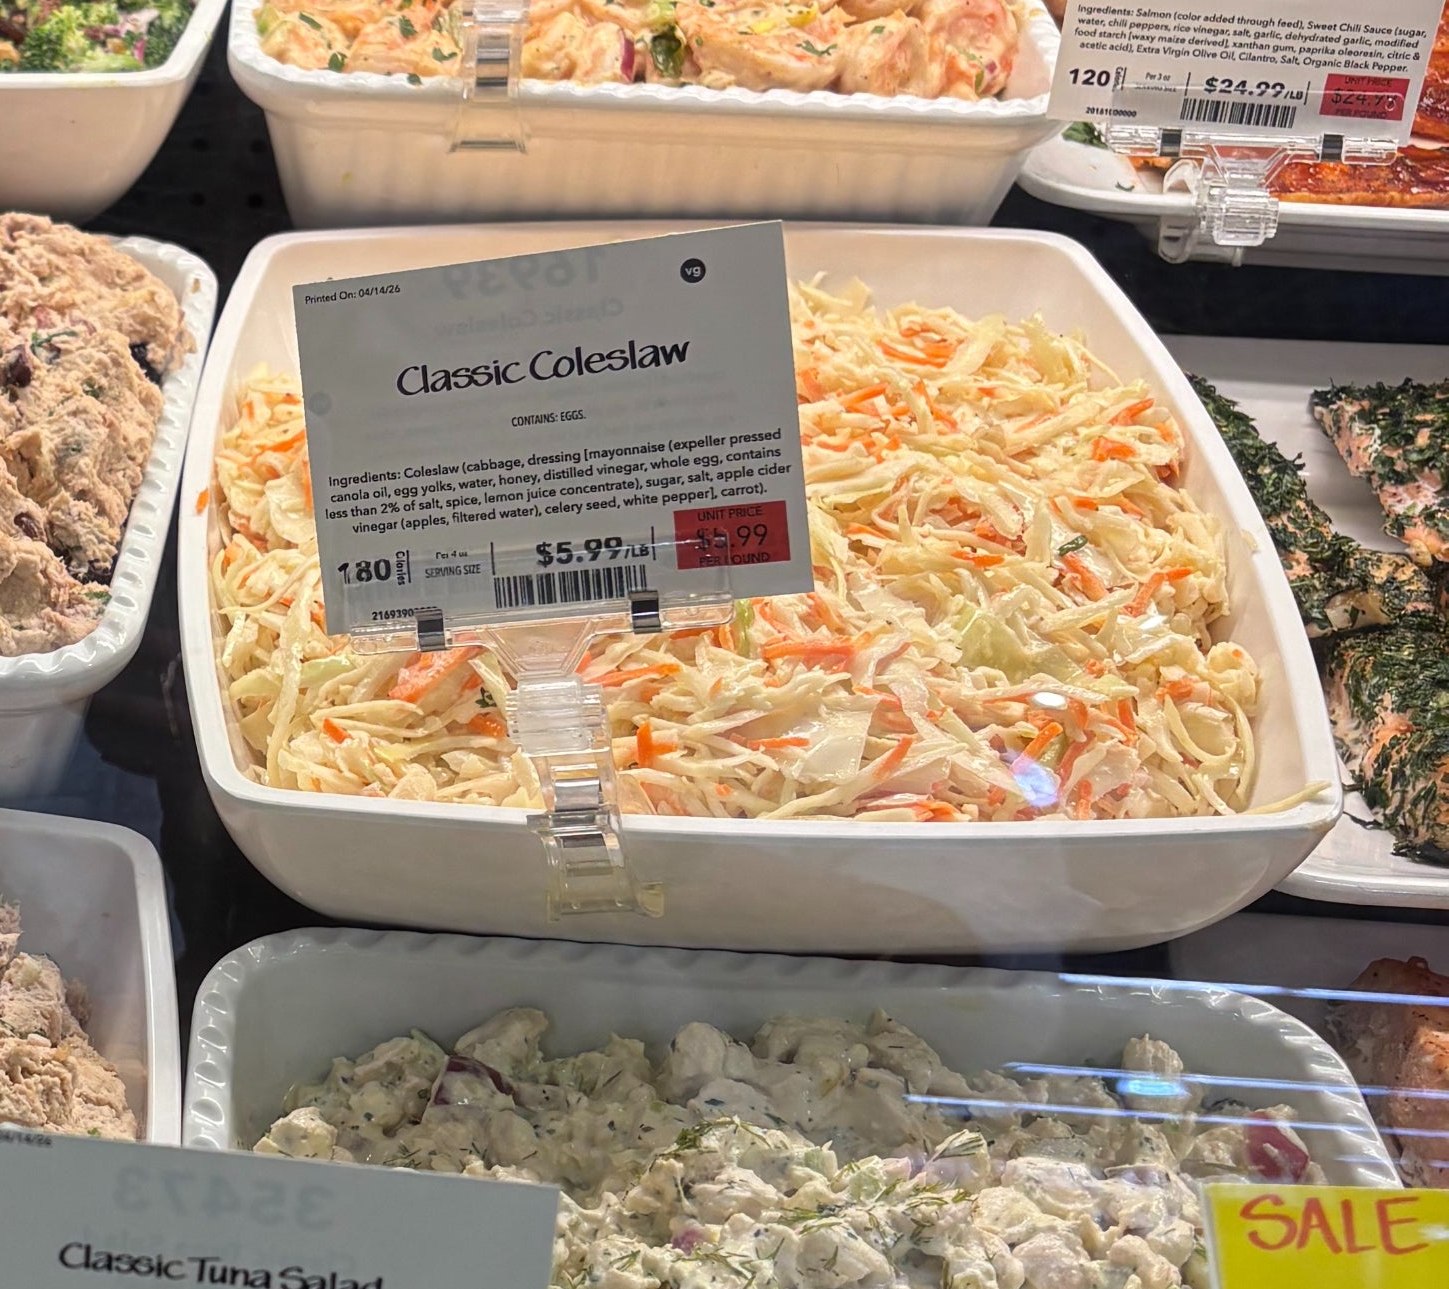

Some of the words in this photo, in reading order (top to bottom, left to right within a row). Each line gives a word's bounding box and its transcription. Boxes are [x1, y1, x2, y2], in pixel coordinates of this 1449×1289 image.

[1077, 4, 1133, 16] Ingredients:
[1135, 8, 1171, 18] Salmon
[1173, 11, 1201, 21] (color
[1203, 13, 1235, 23] added
[1236, 15, 1274, 28] through
[1277, 18, 1304, 29] feed),
[1306, 20, 1337, 30] Sweet
[1338, 22, 1361, 32] Chili
[1362, 24, 1392, 34] Sauce
[1394, 26, 1426, 38] (sugar,
[1069, 68, 1111, 86] 120
[1144, 71, 1156, 80] Per
[1156, 72, 1162, 80] 3
[685, 266, 701, 278] vg
[304, 292, 336, 304] Printed
[338, 290, 356, 299] On:
[358, 284, 400, 297] 04/14/26
[397, 360, 524, 395] Classic
[529, 340, 688, 379] Coleslaw
[511, 412, 558, 426] CONTAINS:
[560, 409, 586, 421] EGGS.
[328, 471, 400, 488] Ingredients:
[403, 464, 459, 478] Coleslaw
[461, 458, 524, 474] (cabbage,
[527, 451, 580, 465] dressing
[583, 442, 664, 461] [mayonnaise
[668, 436, 725, 452] (expeller
[729, 429, 781, 447] pressed
[330, 489, 369, 502] canola
[372, 486, 391, 498] oil,
[393, 486, 418, 498] egg
[420, 480, 455, 496] yolks,
[458, 478, 495, 489] water,
[498, 474, 540, 485] honey,
[543, 464, 593, 480] distilled
[596, 462, 647, 475] vinegar,
[649, 455, 689, 469] whole
[693, 455, 722, 467] egg,
[725, 447, 781, 461] contains
[325, 508, 348, 519] less
[350, 505, 377, 517] than
[380, 501, 400, 513] 2%
[402, 499, 415, 511] of
[418, 497, 443, 510] salt,
[445, 495, 481, 509] spice,
[484, 492, 523, 503] lemon
[526, 487, 556, 502] juice
[559, 477, 642, 495] concentrate),
[645, 475, 684, 488] sugar,
[687, 470, 713, 483] salt,
[716, 466, 753, 482] apple
[757, 463, 791, 475] cider
[698, 511, 726, 522] UNIT
[729, 507, 763, 518] PRICE
[424, 565, 461, 578] SERVING
[462, 563, 481, 575] SIZE
[1239, 1194, 1429, 1255] SALE
[58, 1242, 183, 1279] Classic
[189, 1257, 271, 1289] Tuna
